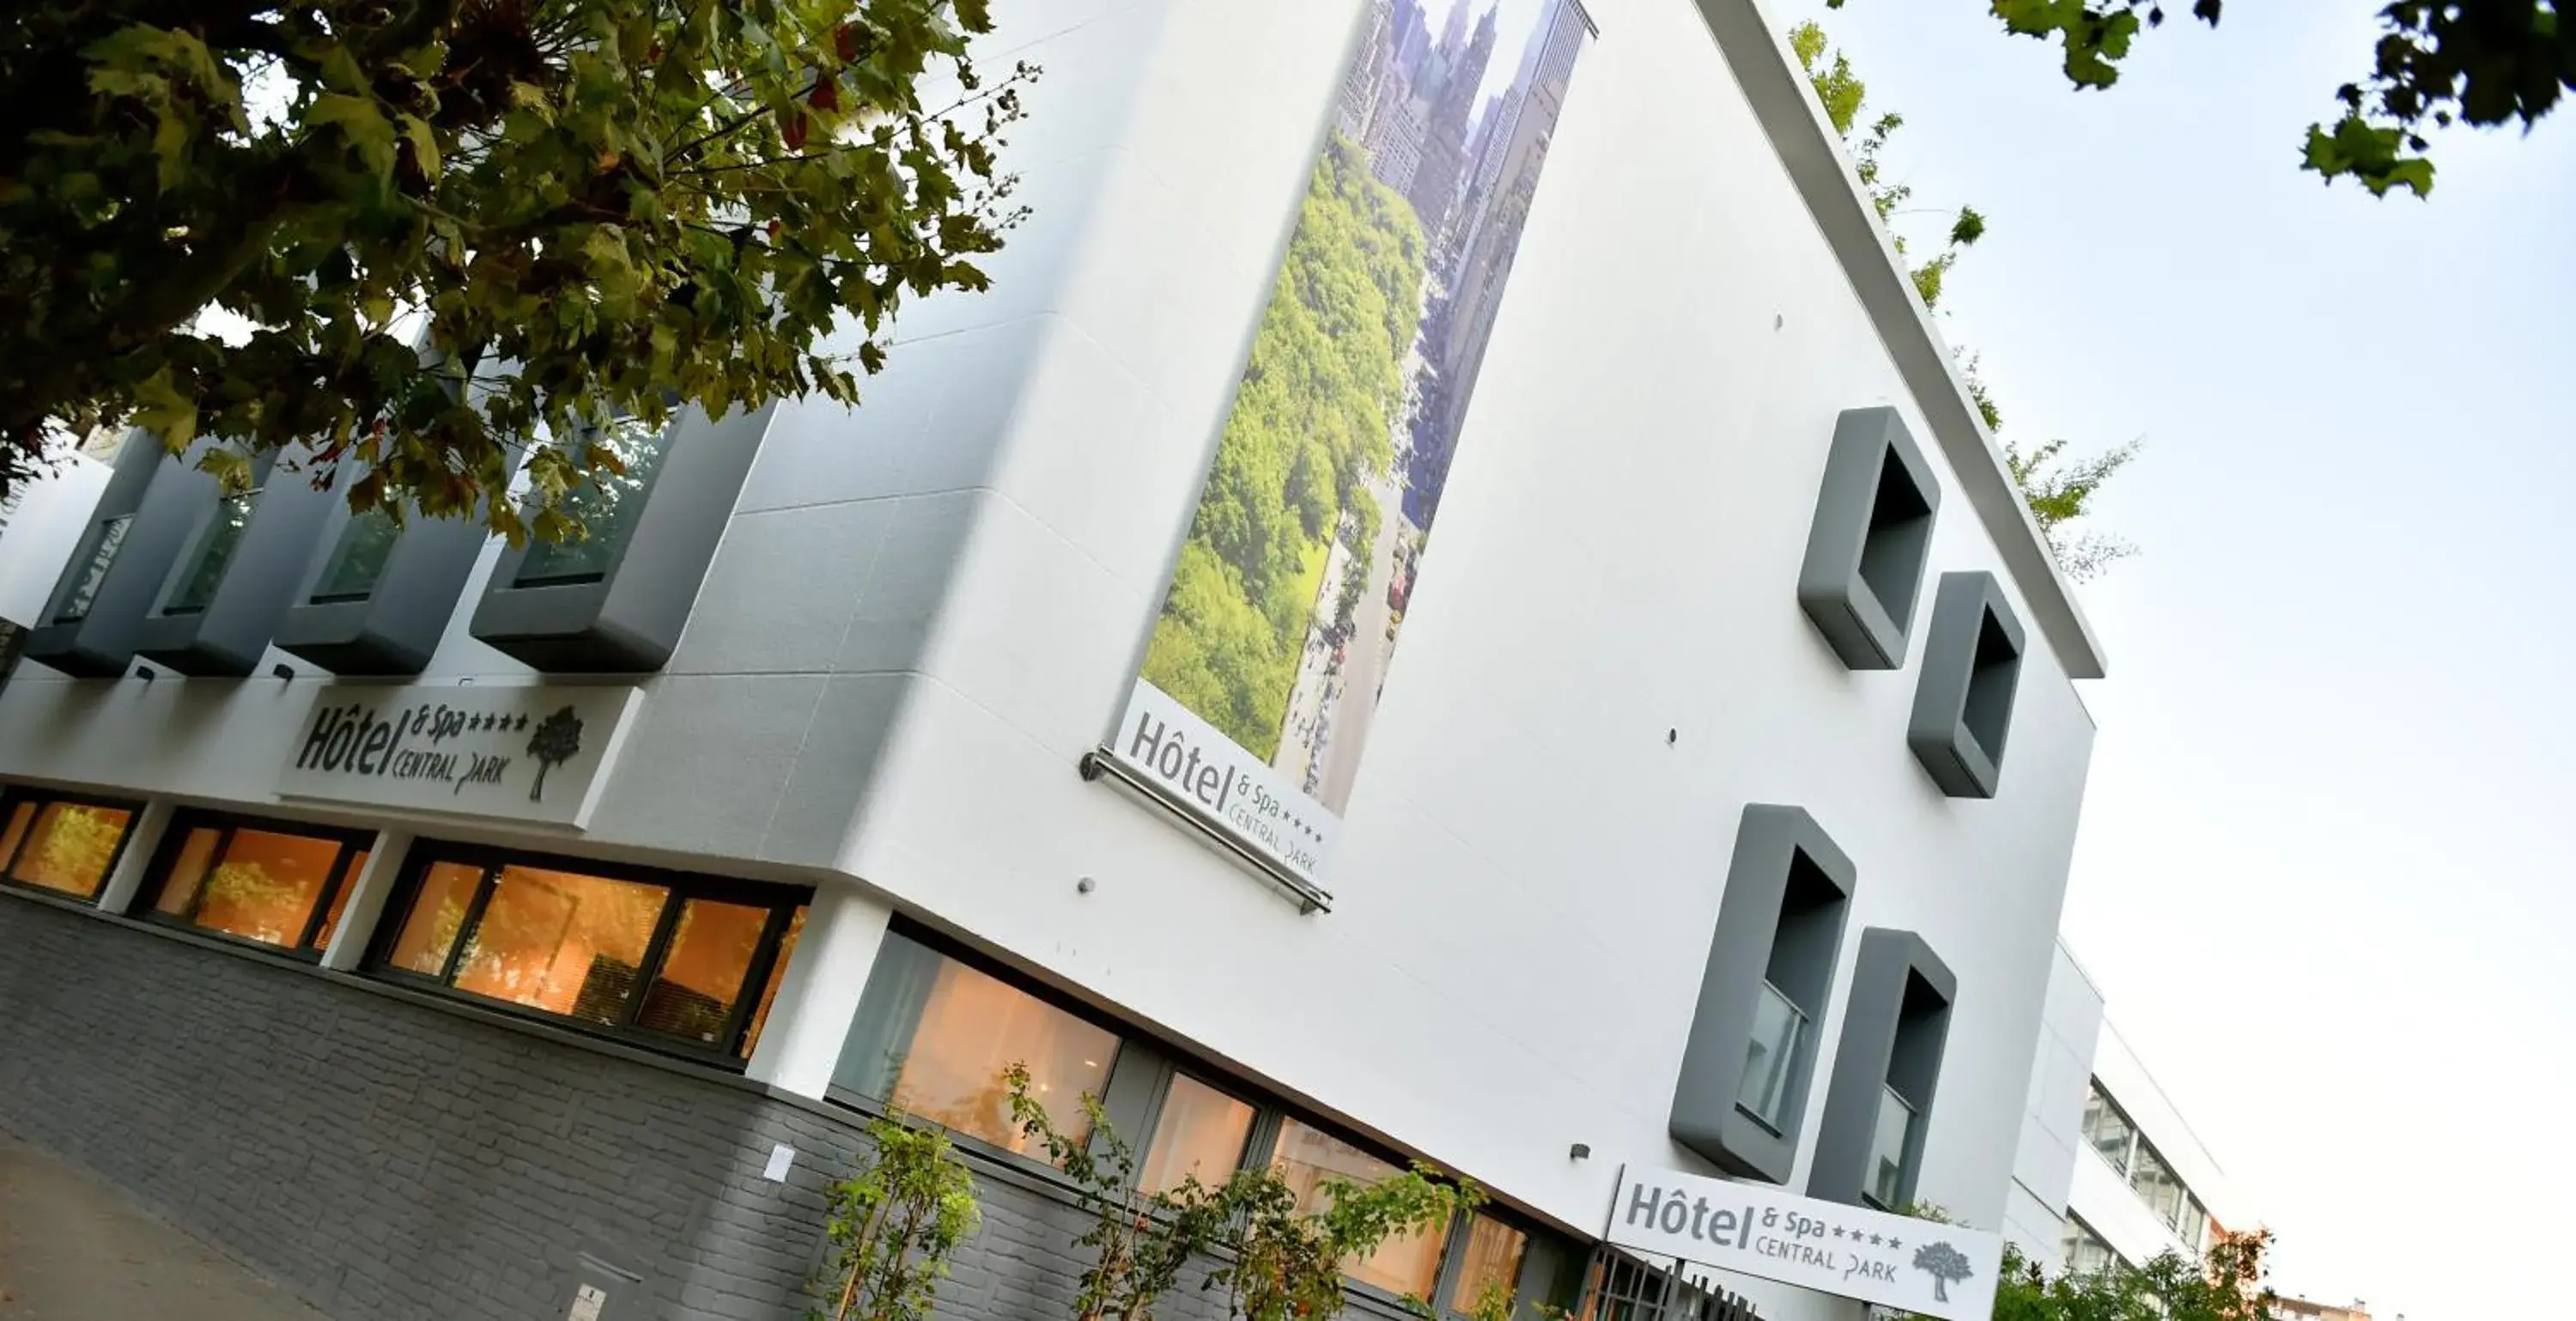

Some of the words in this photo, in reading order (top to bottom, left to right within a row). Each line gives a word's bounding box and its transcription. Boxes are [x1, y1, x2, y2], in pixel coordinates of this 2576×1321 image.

[296, 703, 412, 776] Hôtel
[410, 703, 430, 736] &
[428, 703, 467, 746] Spa
[392, 748, 459, 782] CENTRAL
[453, 751, 512, 795] PARK
[1129, 711, 1236, 813] Hôtel
[1237, 774, 1251, 797] &
[1252, 784, 1279, 818] Spa
[1229, 802, 1280, 853] CENTRAL
[1284, 839, 1318, 875] PARK
[1626, 1183, 1755, 1250] Hôtel
[1761, 1207, 1780, 1227] &
[1783, 1210, 1827, 1239] Spa
[1755, 1235, 1837, 1271] CENTRAL
[1843, 1253, 1899, 1284] PARK
